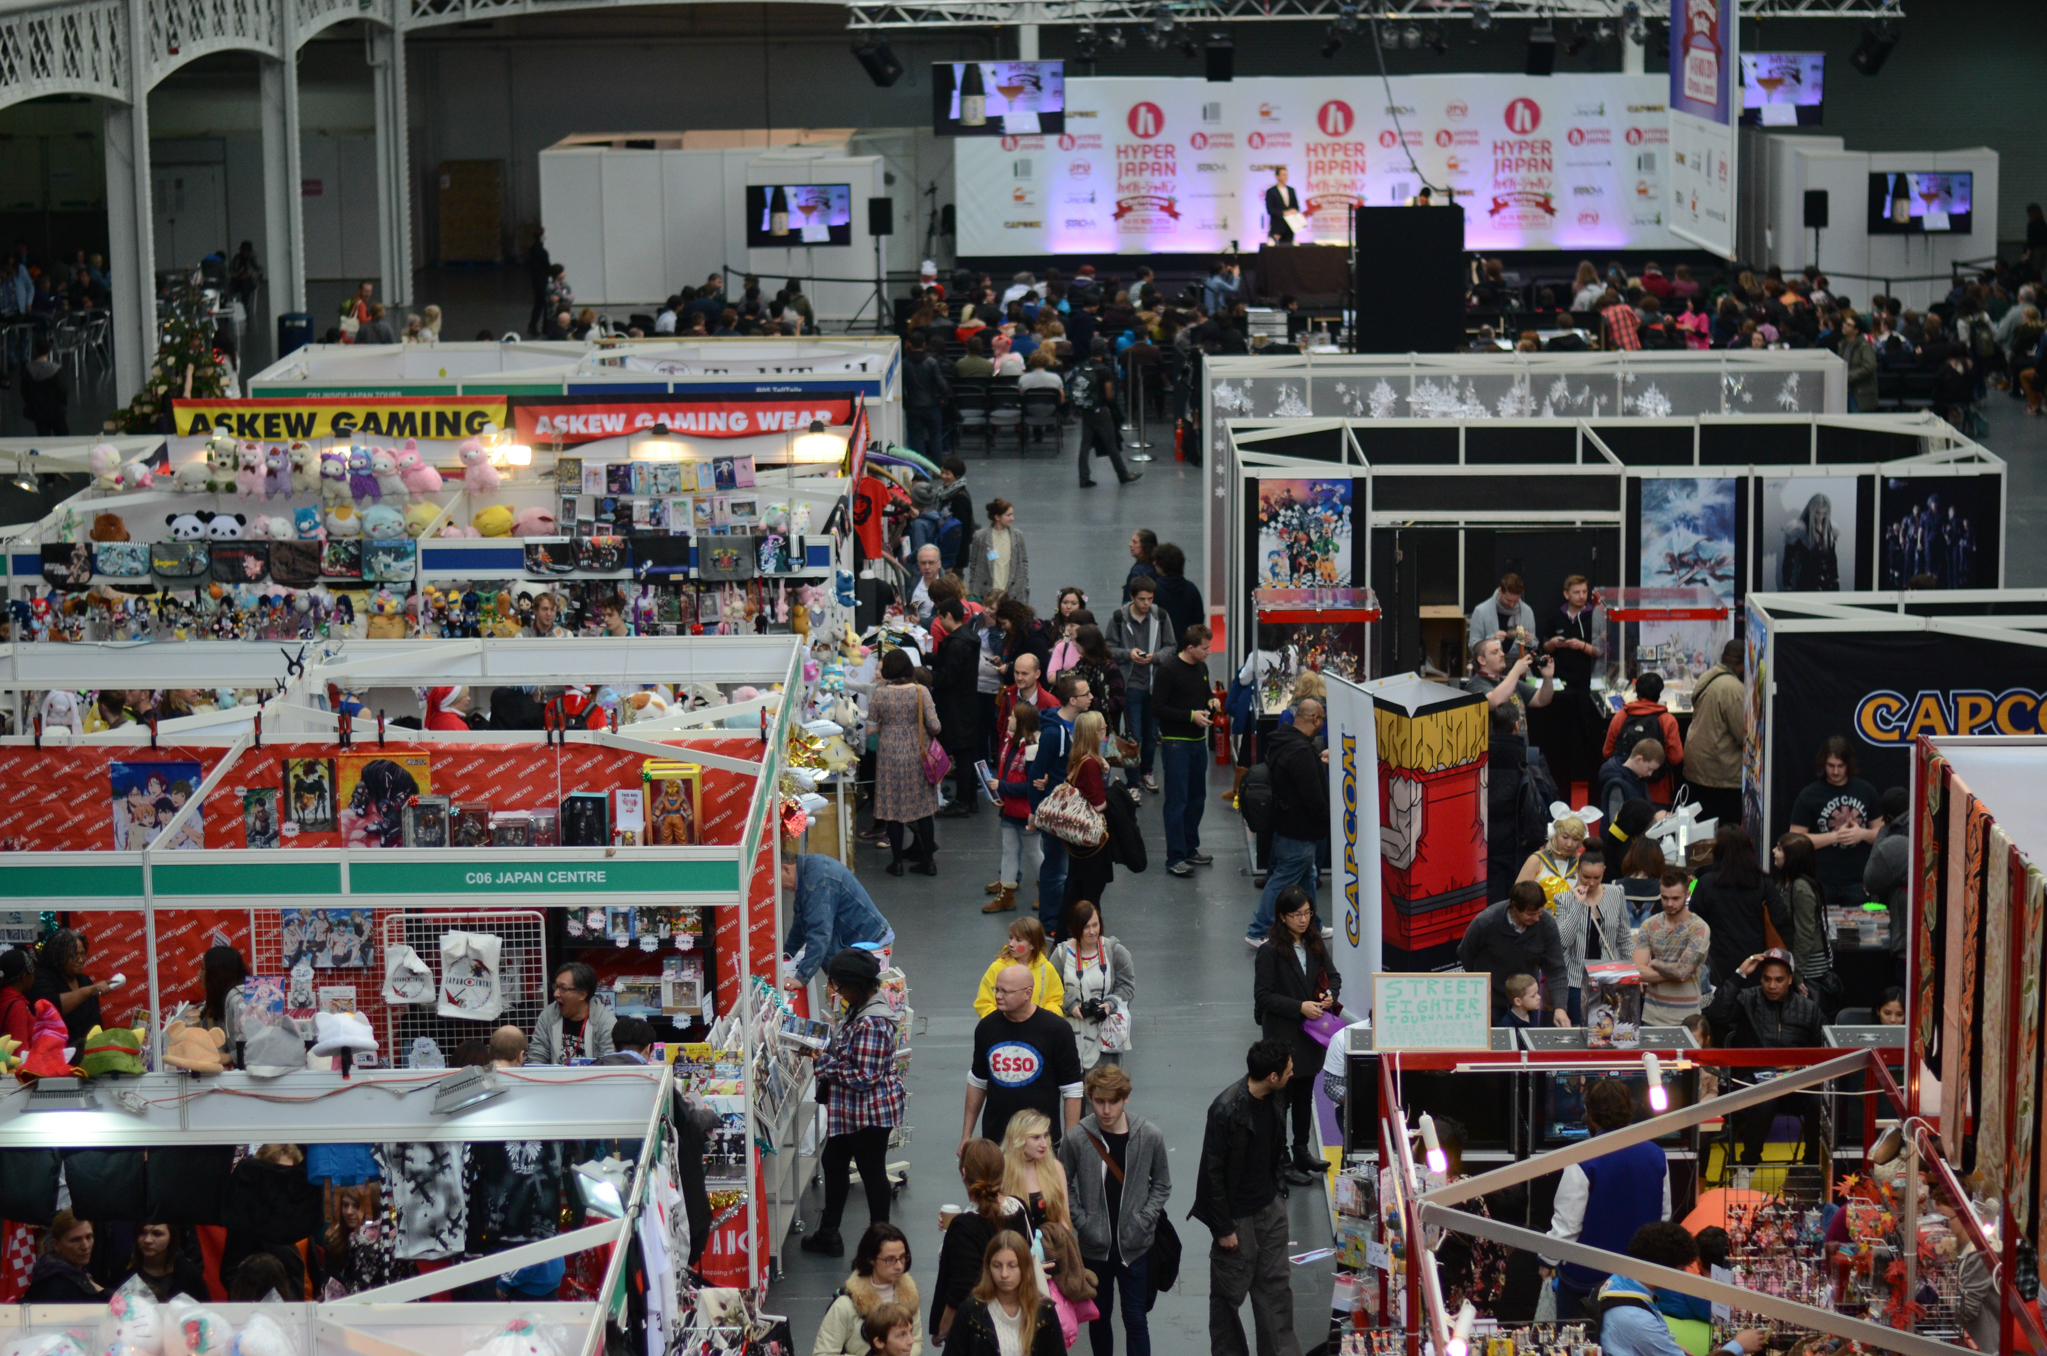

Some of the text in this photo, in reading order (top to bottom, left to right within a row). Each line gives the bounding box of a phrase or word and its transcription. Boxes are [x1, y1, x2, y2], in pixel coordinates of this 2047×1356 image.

[1116, 144, 1176, 160] HYPER
[1306, 142, 1366, 158] HYPER
[1493, 140, 1552, 155] HYPER
[1116, 162, 1176, 180] JAPAN
[1306, 160, 1366, 176] JAPAN
[1494, 158, 1552, 176] JAPAN
[188, 410, 492, 438] ASKEW GAMING
[534, 410, 832, 435] ASKEW GAMING WEAR
[1854, 687, 2047, 748] CAPC
[1821, 796, 1840, 818] HOT
[1342, 732, 1360, 950] CAPCOM
[465, 870, 607, 885] C06 JAPAN CENTRE
[1384, 978, 1484, 1000] STREET
[1384, 998, 1480, 1014] FIGHTER
[1384, 1012, 1482, 1025] TOURNAMENT
